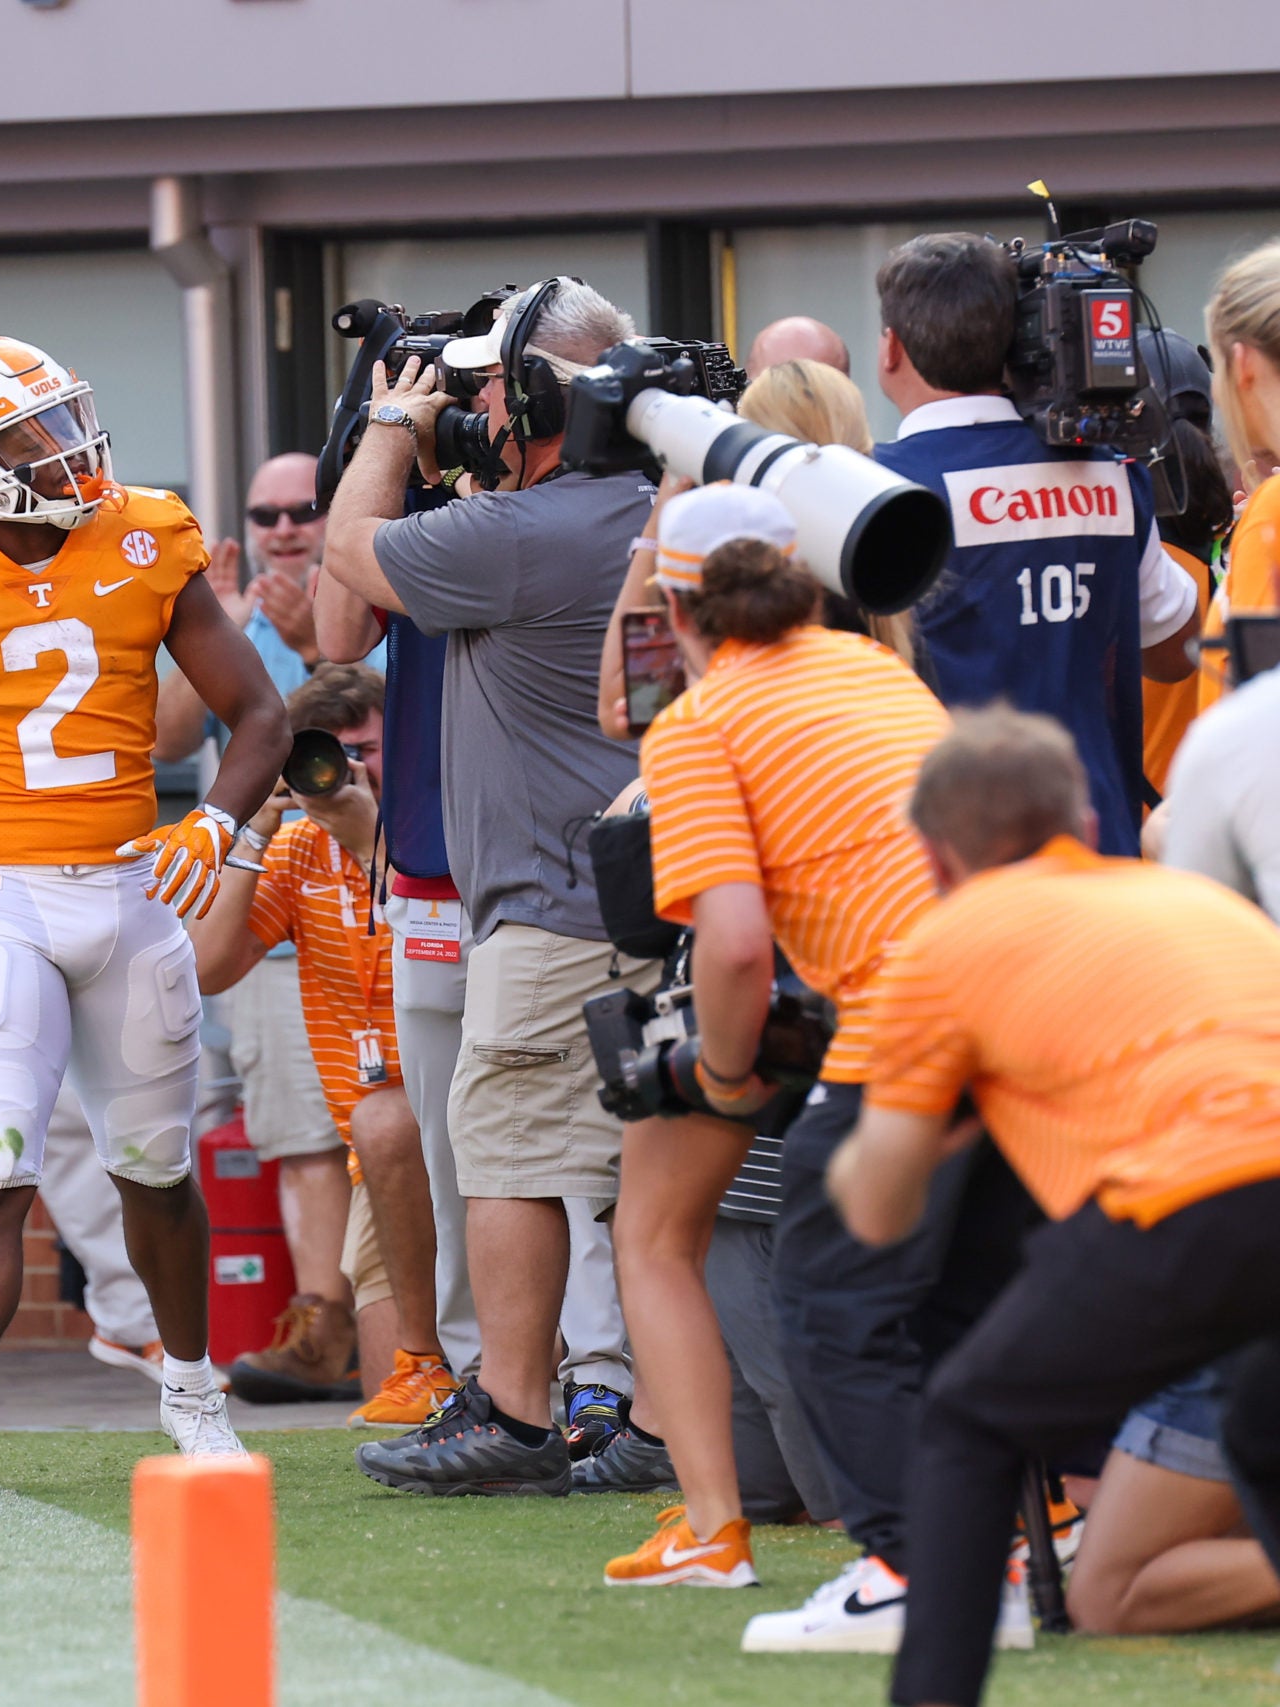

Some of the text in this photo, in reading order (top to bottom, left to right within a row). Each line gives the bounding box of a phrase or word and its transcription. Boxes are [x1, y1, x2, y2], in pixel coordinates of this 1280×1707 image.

[1099, 302, 1122, 336] 5
[1095, 339, 1129, 349] WTVF
[30, 377, 61, 397] VOLS
[970, 485, 1118, 525] Canon
[121, 530, 158, 565] SEC
[28, 582, 53, 608] T
[1017, 563, 1096, 625] 105
[0, 617, 117, 790] 2
[406, 948, 435, 956] SEPTEMBER
[358, 1038, 382, 1068] AA
